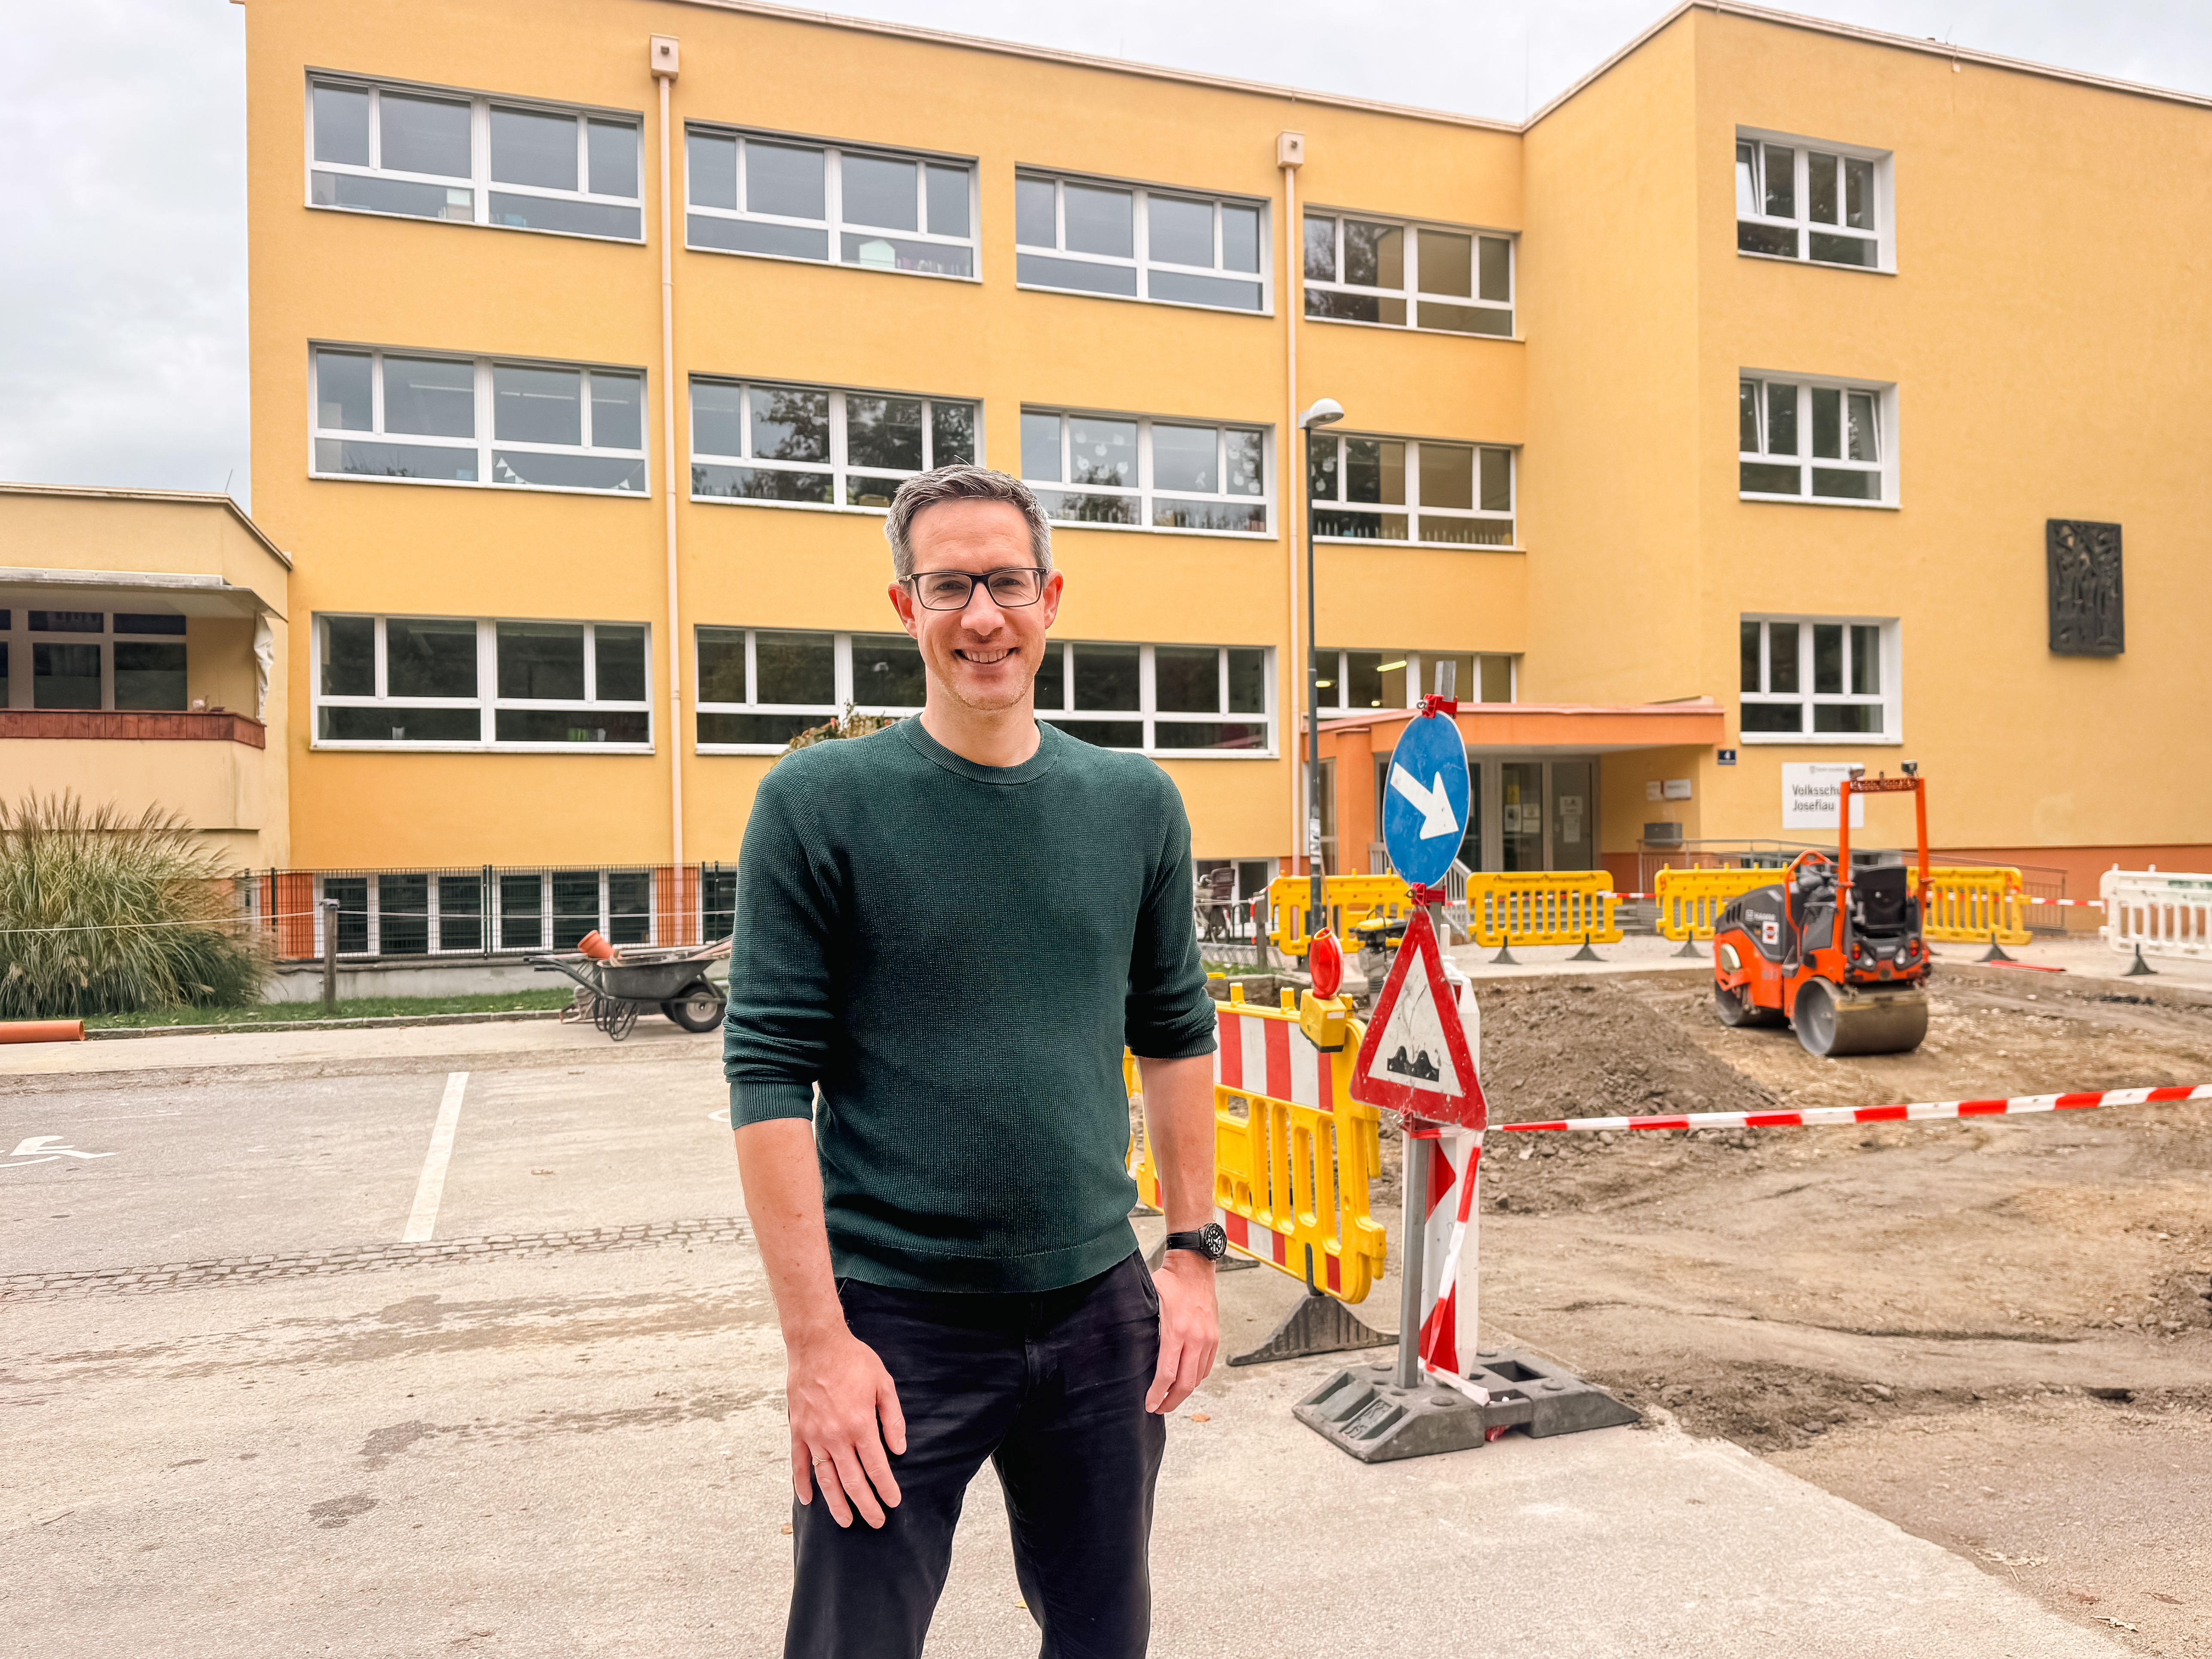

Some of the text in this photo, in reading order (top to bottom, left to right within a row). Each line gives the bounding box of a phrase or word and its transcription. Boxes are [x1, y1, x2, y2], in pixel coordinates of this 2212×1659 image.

[1723, 750, 1730, 760] 4
[1792, 784, 1841, 795] Volksschu
[1793, 799, 1834, 810] Josefiau
